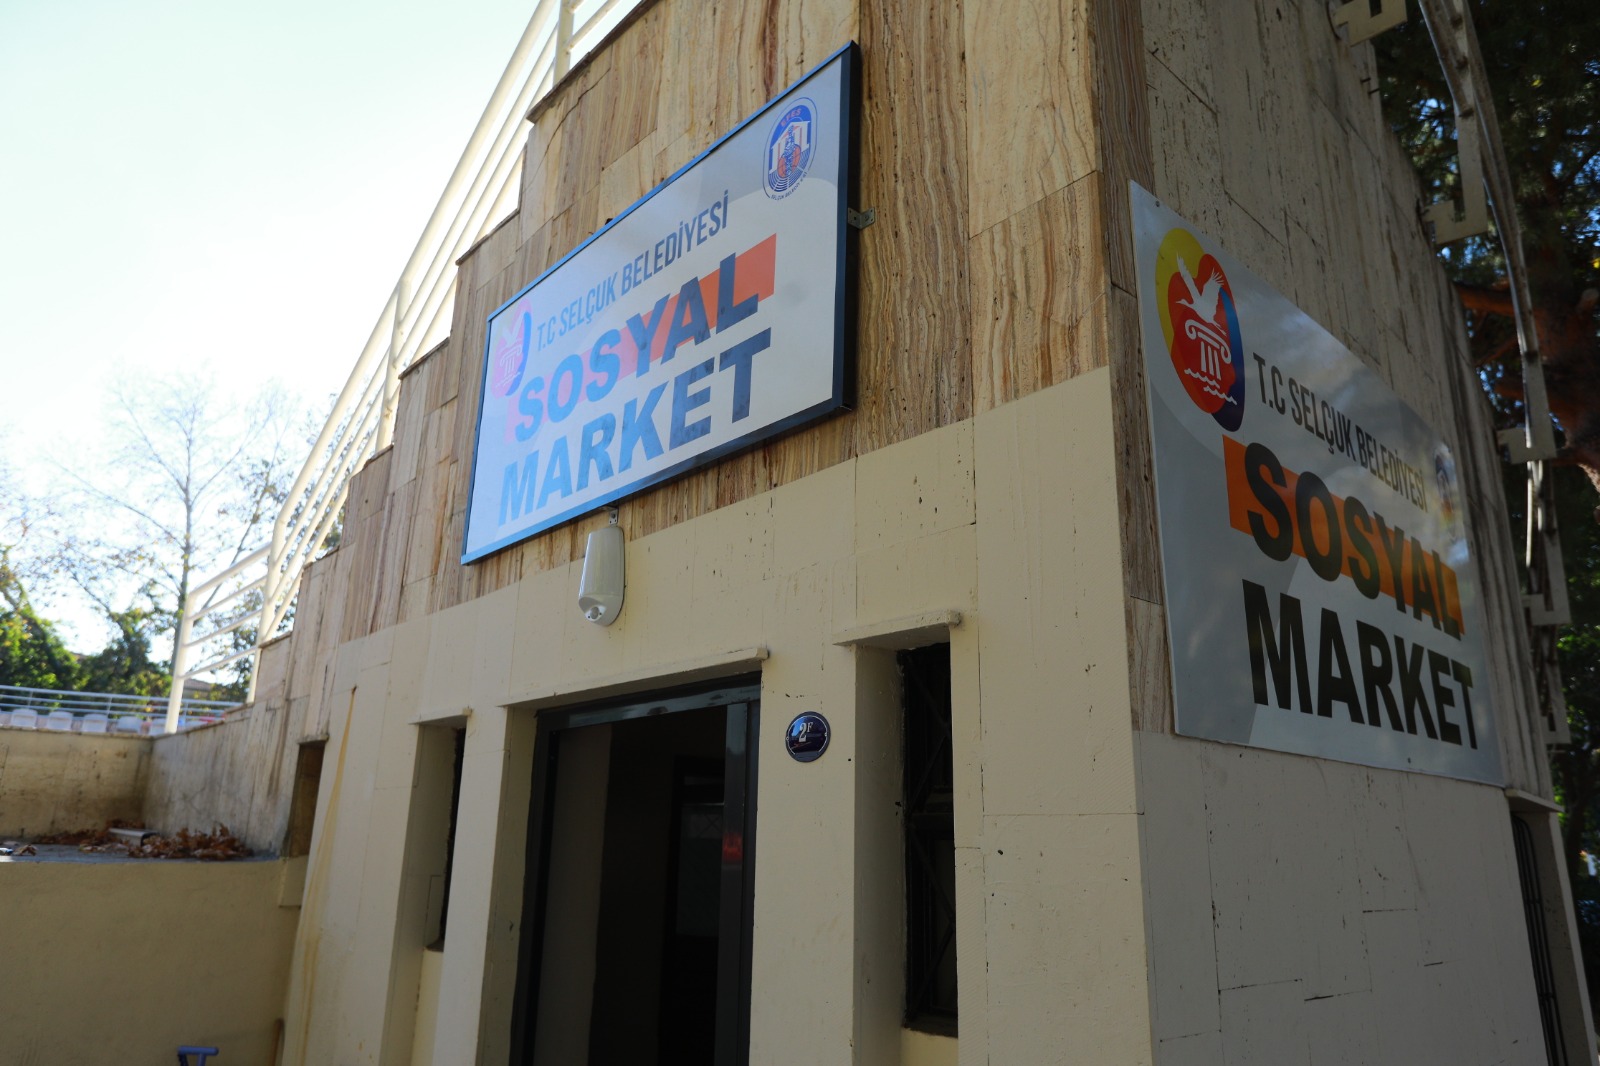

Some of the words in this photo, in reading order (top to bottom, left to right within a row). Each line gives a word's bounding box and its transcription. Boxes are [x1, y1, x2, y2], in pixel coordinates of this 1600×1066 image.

[515, 252, 759, 442] SOSYAL
[559, 272, 618, 325] SELÇUK
[621, 189, 729, 297] BELEDİYESİ
[498, 327, 772, 527] MARKET
[1288, 377, 1357, 462] SELÇUK
[1355, 424, 1428, 513] BELEDİYESİ
[1244, 442, 1464, 640] SOSYAL
[1241, 578, 1478, 750] MARKET
